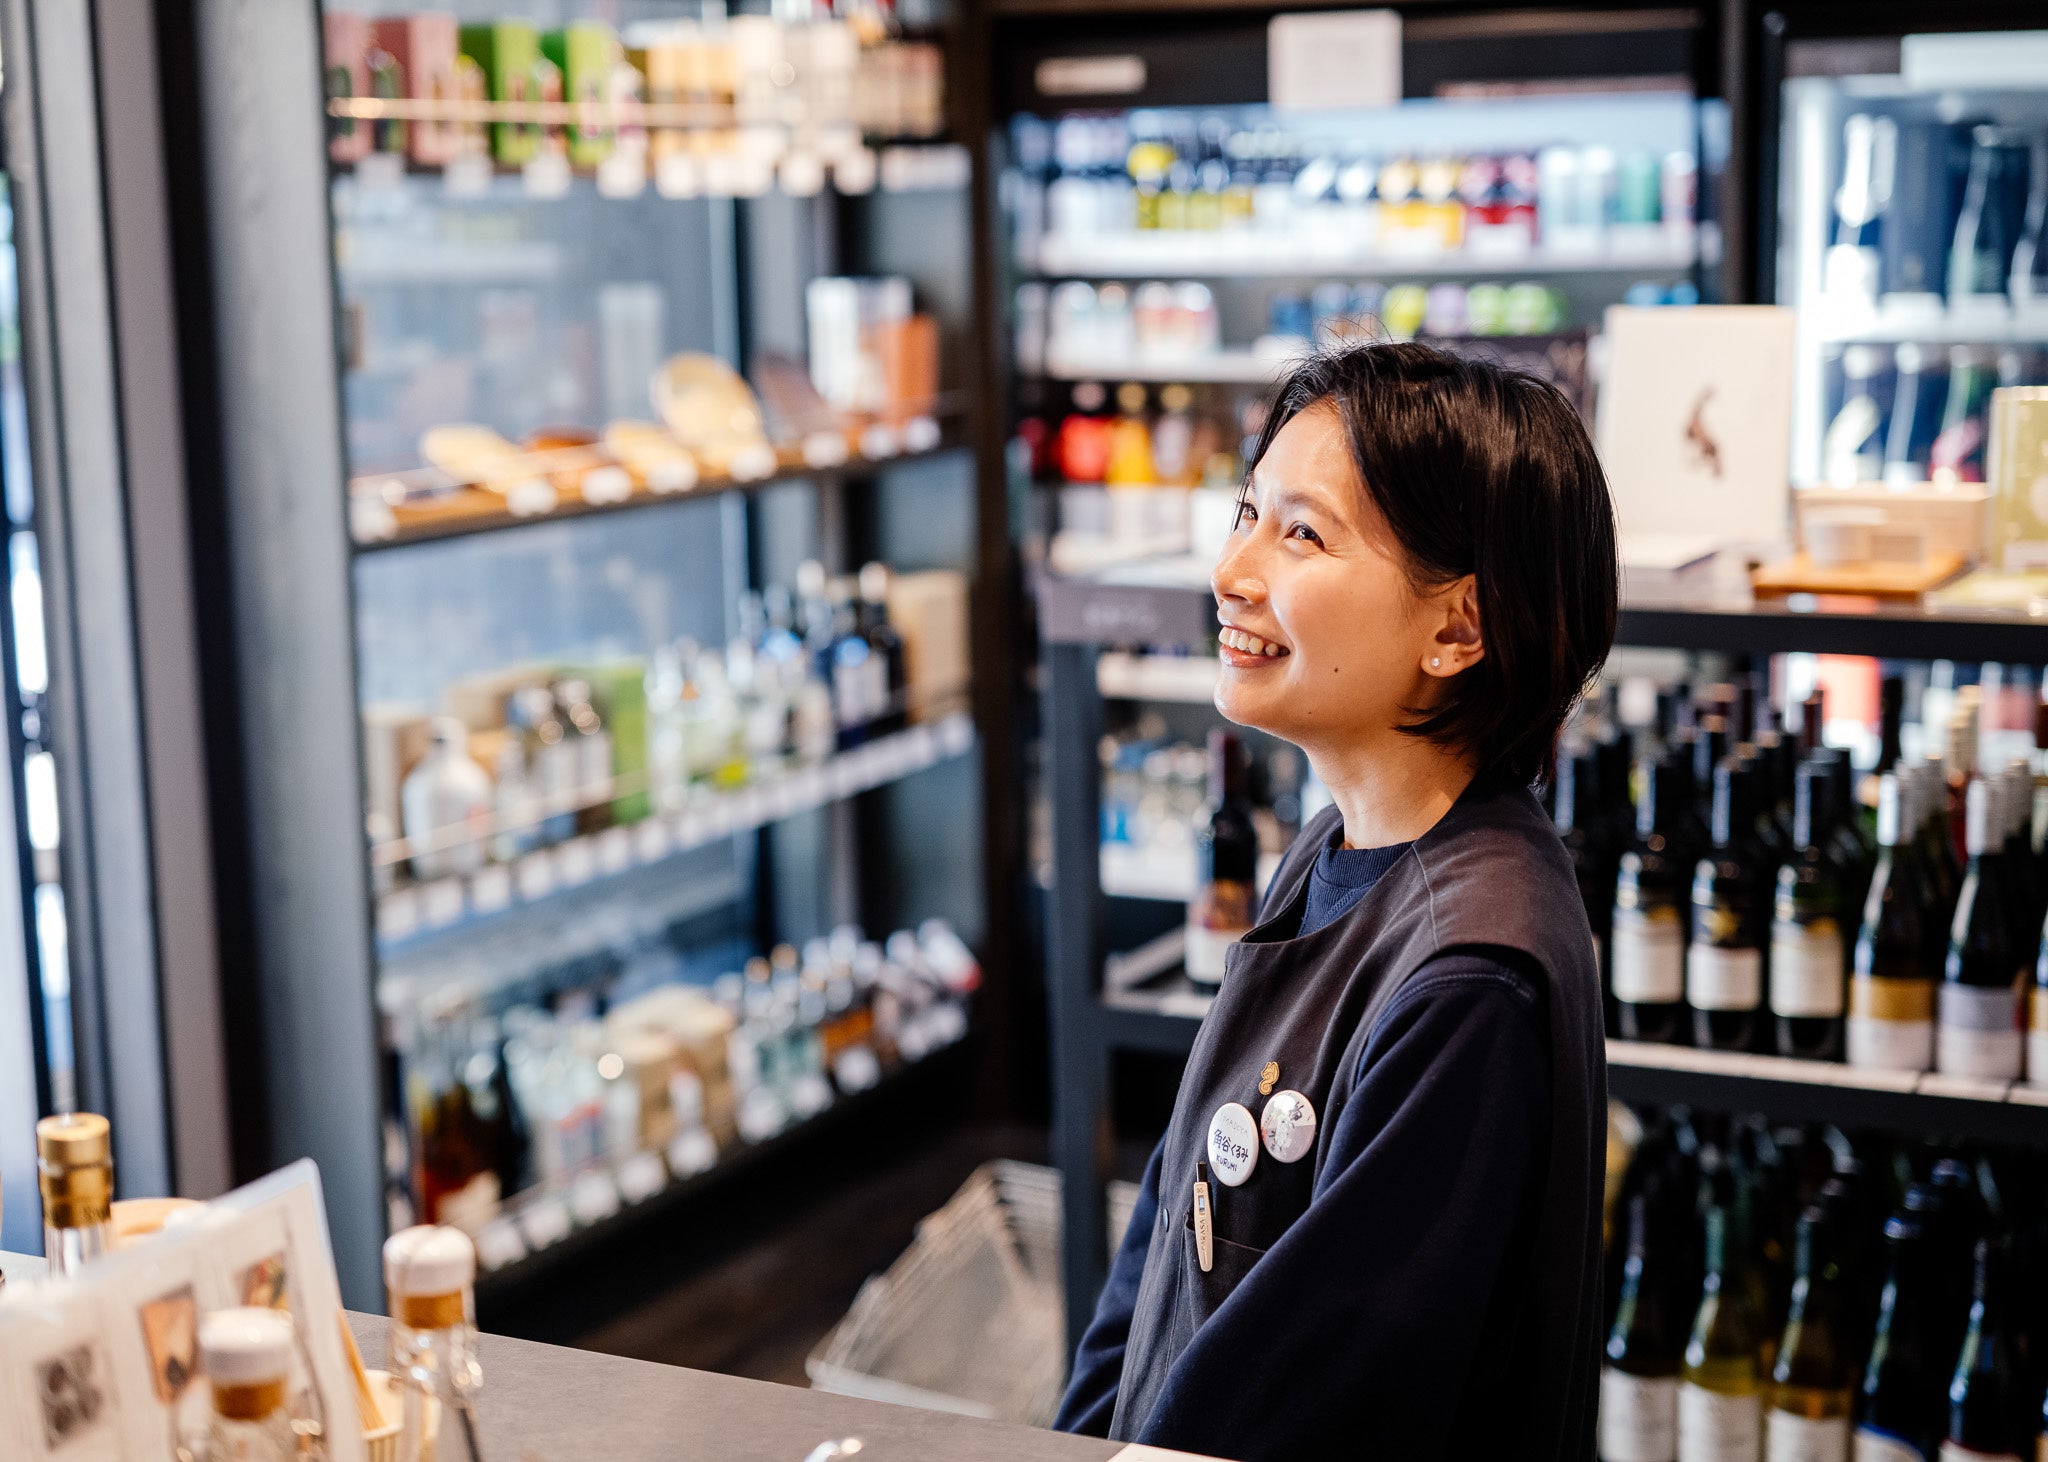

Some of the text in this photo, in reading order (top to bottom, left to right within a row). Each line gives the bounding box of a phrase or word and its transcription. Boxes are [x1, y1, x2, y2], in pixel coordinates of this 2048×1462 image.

[1213, 1129, 1249, 1163] 角谷くるみ
[1216, 1154, 1238, 1172] KURUMI
